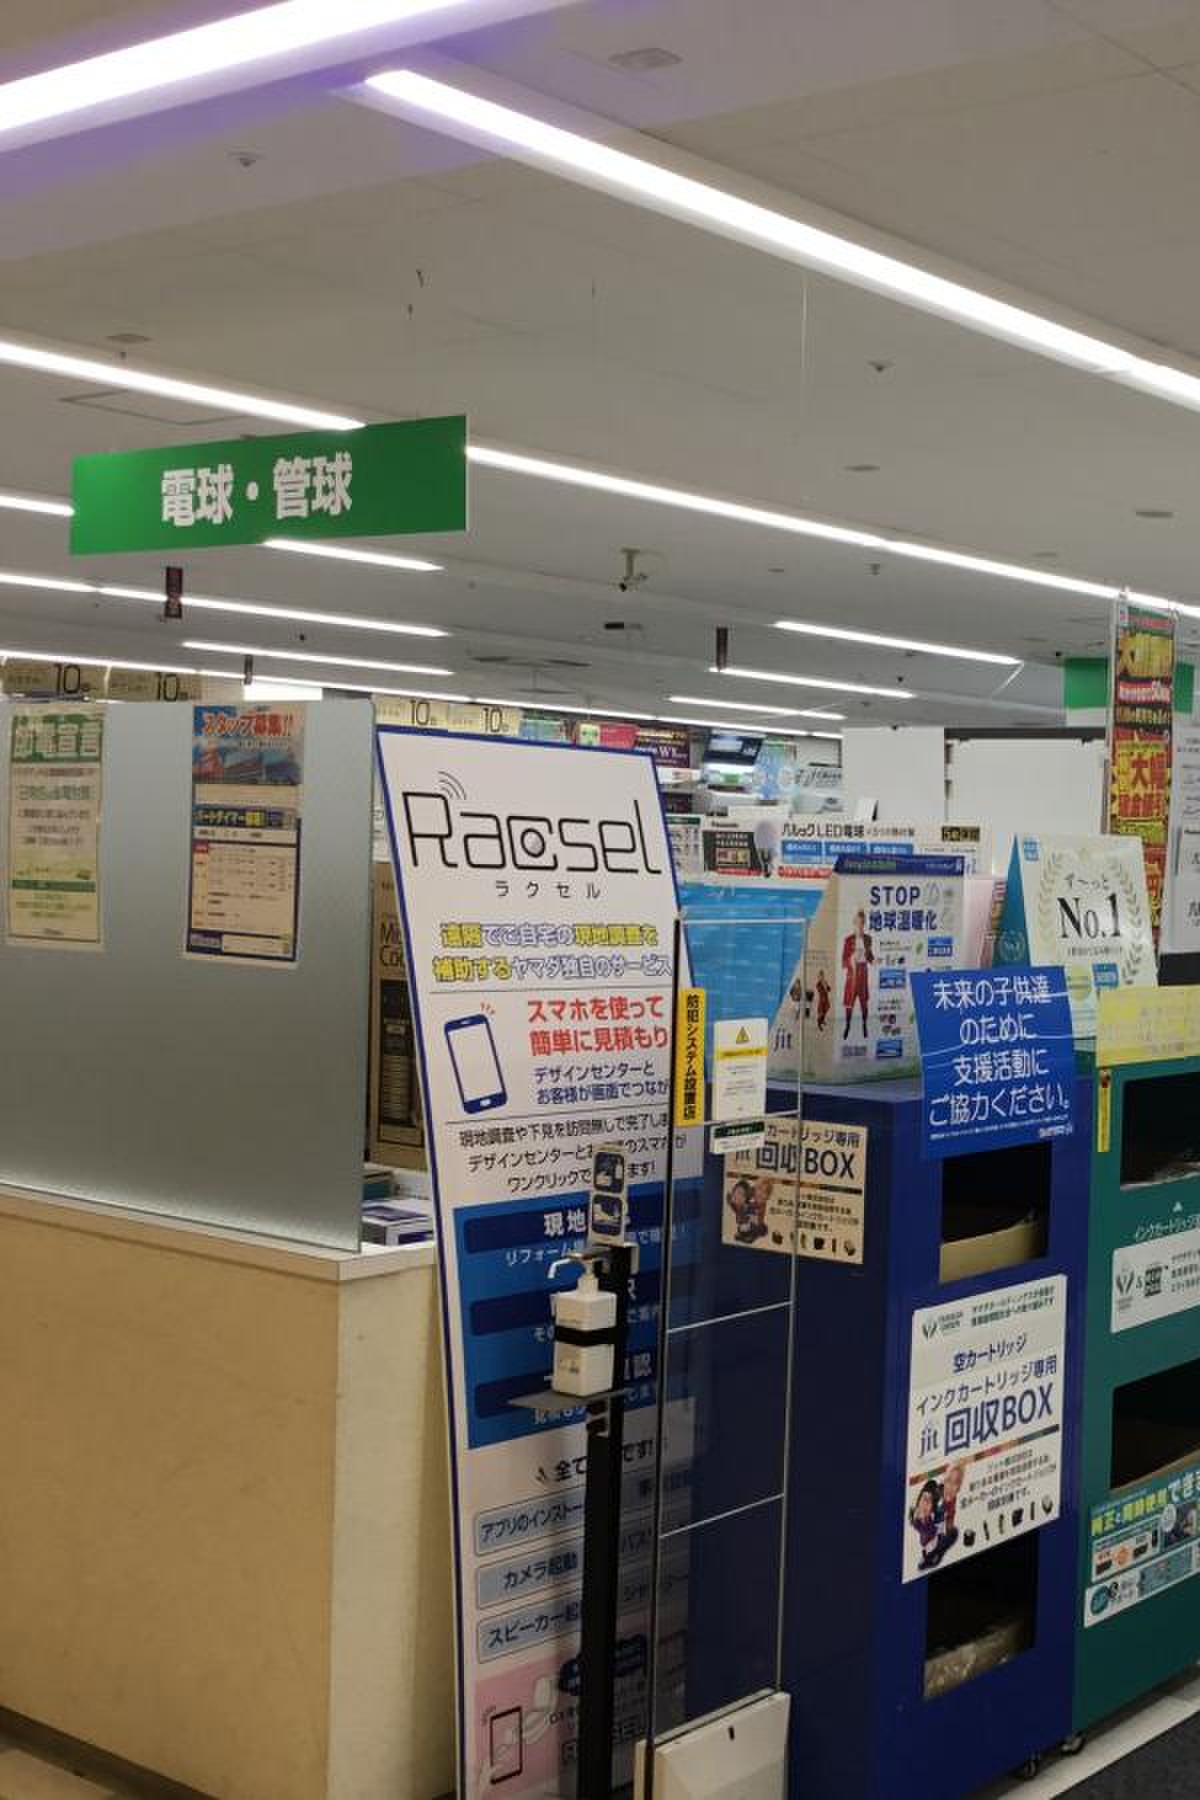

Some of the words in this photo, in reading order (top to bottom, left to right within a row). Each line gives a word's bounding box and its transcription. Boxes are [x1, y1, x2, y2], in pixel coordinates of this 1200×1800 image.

[160, 452, 353, 526] 電球・管球
[401, 790, 662, 875] Racsel
[495, 881, 601, 899] ラクセル
[870, 885, 921, 905] STOP
[868, 909, 938, 932] 地球温暖化
[1057, 891, 1121, 939] No.1
[527, 996, 664, 1023] スマホを使って
[933, 976, 1052, 1011] 未来の子供達
[529, 1026, 669, 1057] 簡単に見積もり
[960, 1013, 1037, 1045] のために
[534, 1060, 655, 1082] デザインセンターと
[953, 1049, 1049, 1087] 支援活動に
[929, 1082, 1070, 1126] ご協力ください。
[953, 1332, 1027, 1374] 空カートリッジ
[916, 1354, 1058, 1416] インクカートリッジ専用
[944, 1381, 1055, 1456] 回収BOX
